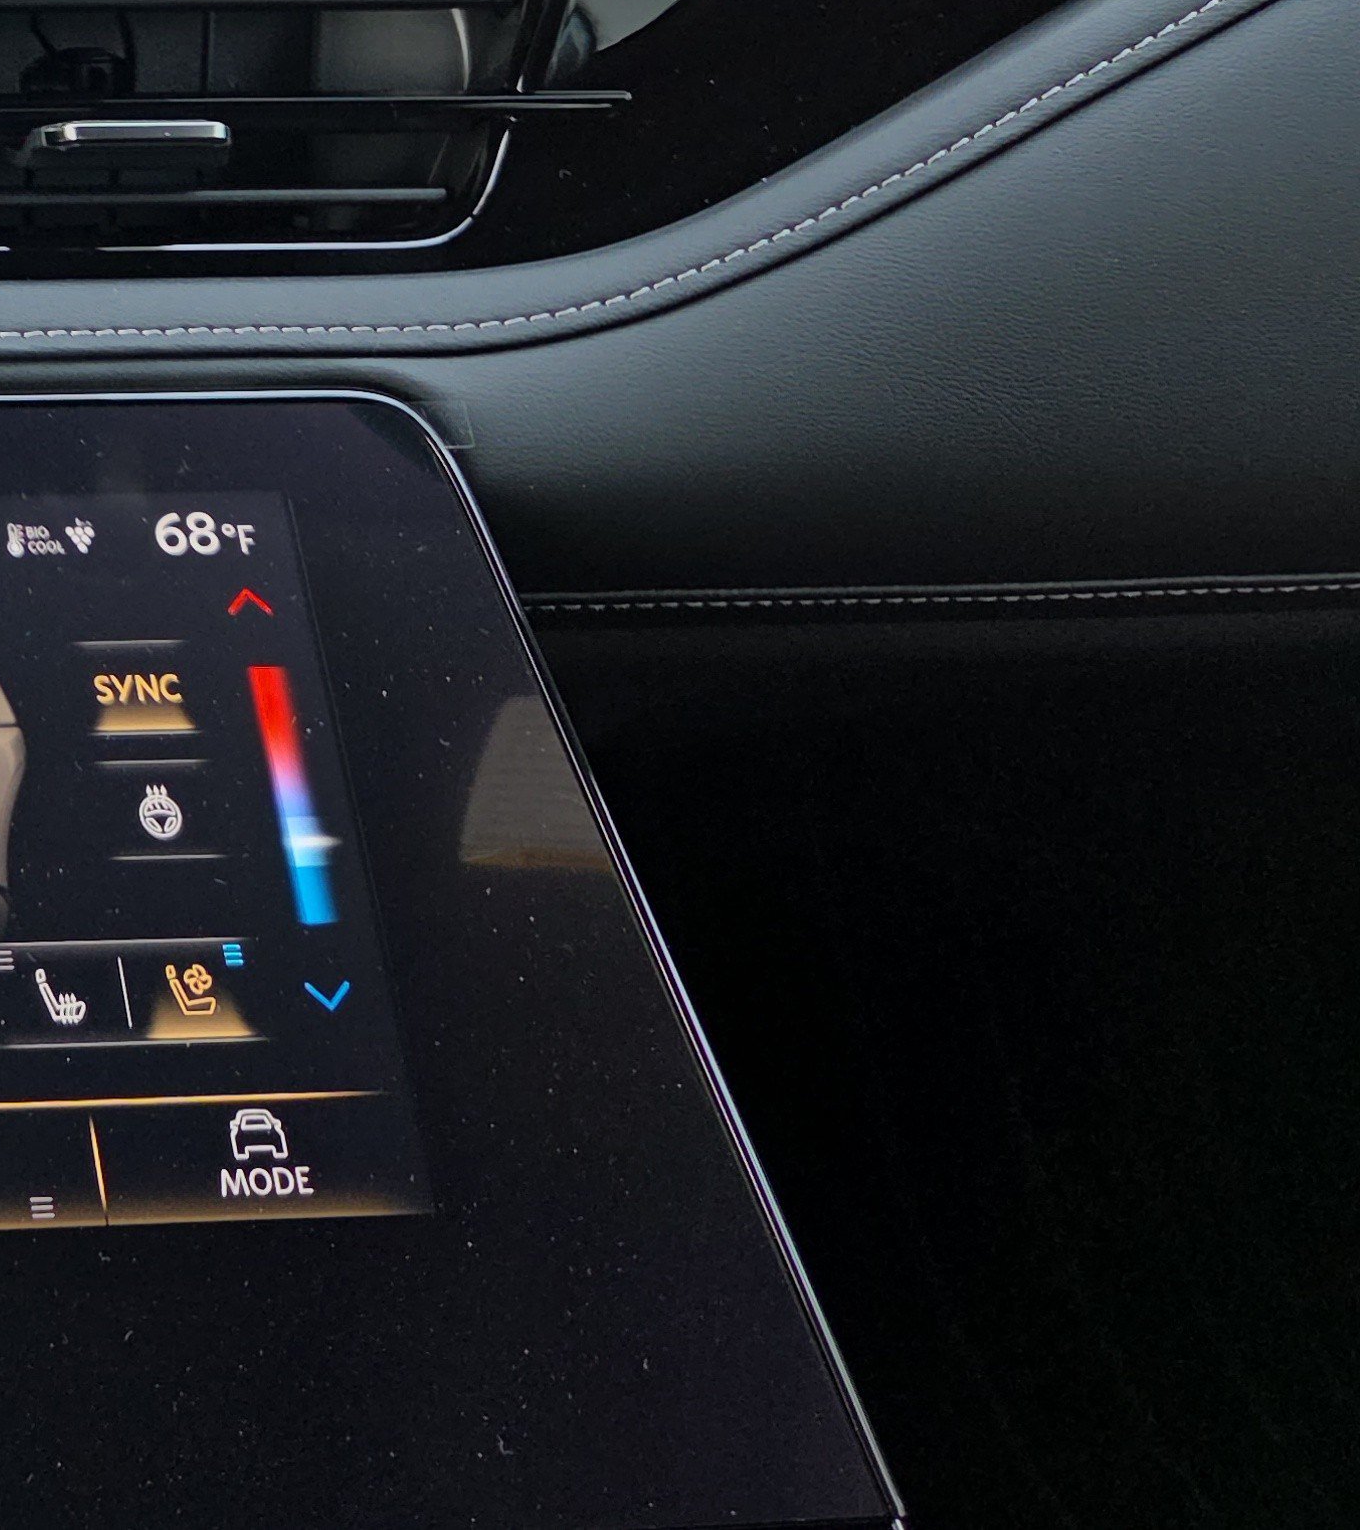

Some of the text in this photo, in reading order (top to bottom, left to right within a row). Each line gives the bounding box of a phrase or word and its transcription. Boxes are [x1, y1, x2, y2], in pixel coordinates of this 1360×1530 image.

[25, 525, 50, 540] BIO
[27, 540, 66, 556] COOL
[93, 673, 182, 705] SYNC
[220, 1166, 315, 1198] MODE
